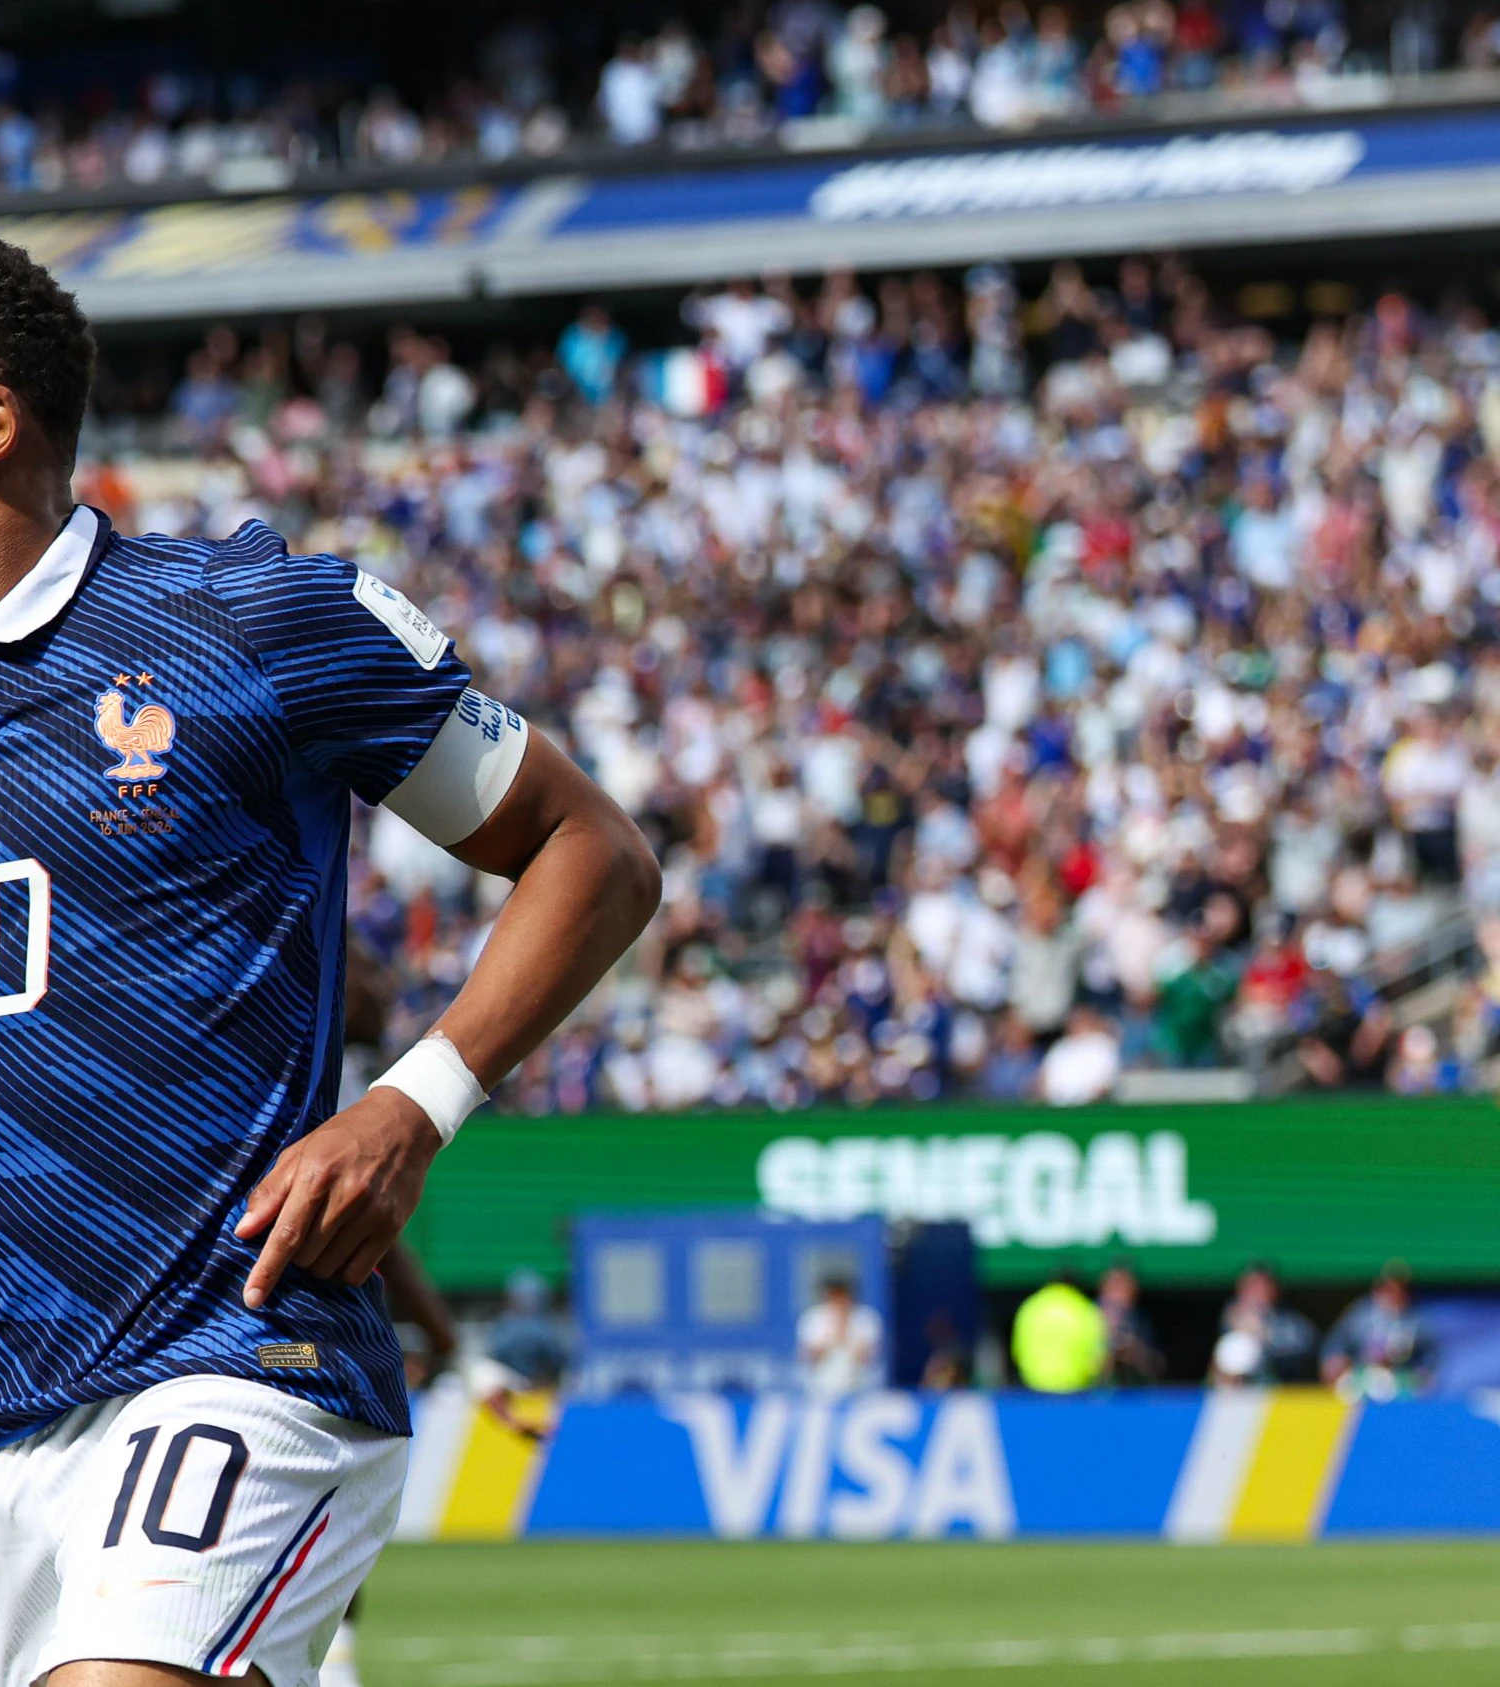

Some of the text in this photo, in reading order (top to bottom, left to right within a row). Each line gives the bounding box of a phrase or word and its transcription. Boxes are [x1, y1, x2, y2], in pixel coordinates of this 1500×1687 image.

[90, 809, 128, 823] FRANCE
[118, 784, 158, 799] FFF
[100, 823, 112, 836] 16
[756, 1130, 1217, 1248] SENEGAL
[103, 1423, 251, 1553] 10
[655, 1390, 1018, 1542] VISA
